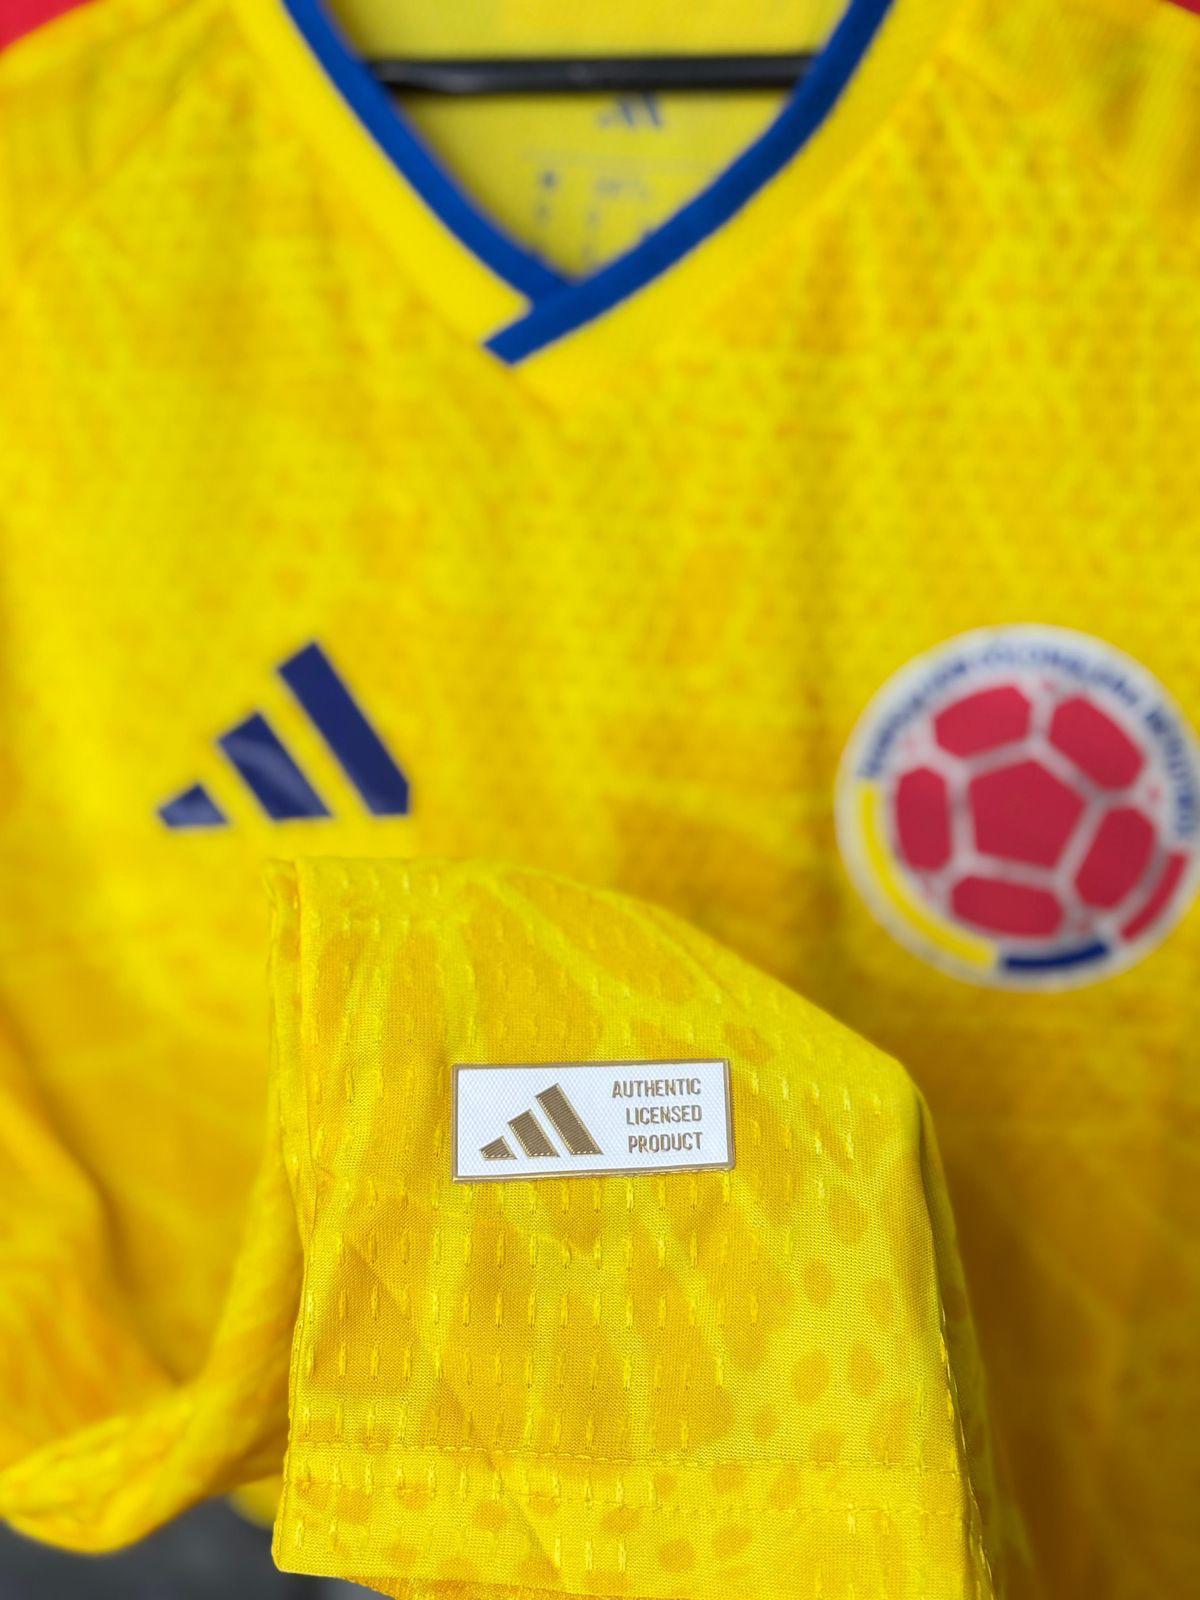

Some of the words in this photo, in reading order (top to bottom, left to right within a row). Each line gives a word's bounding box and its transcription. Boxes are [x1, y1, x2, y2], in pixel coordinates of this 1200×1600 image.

[612, 1077, 702, 1099] AUTHENTIC
[626, 1104, 703, 1126] LICENSED
[628, 1131, 704, 1154] PRODUCT
